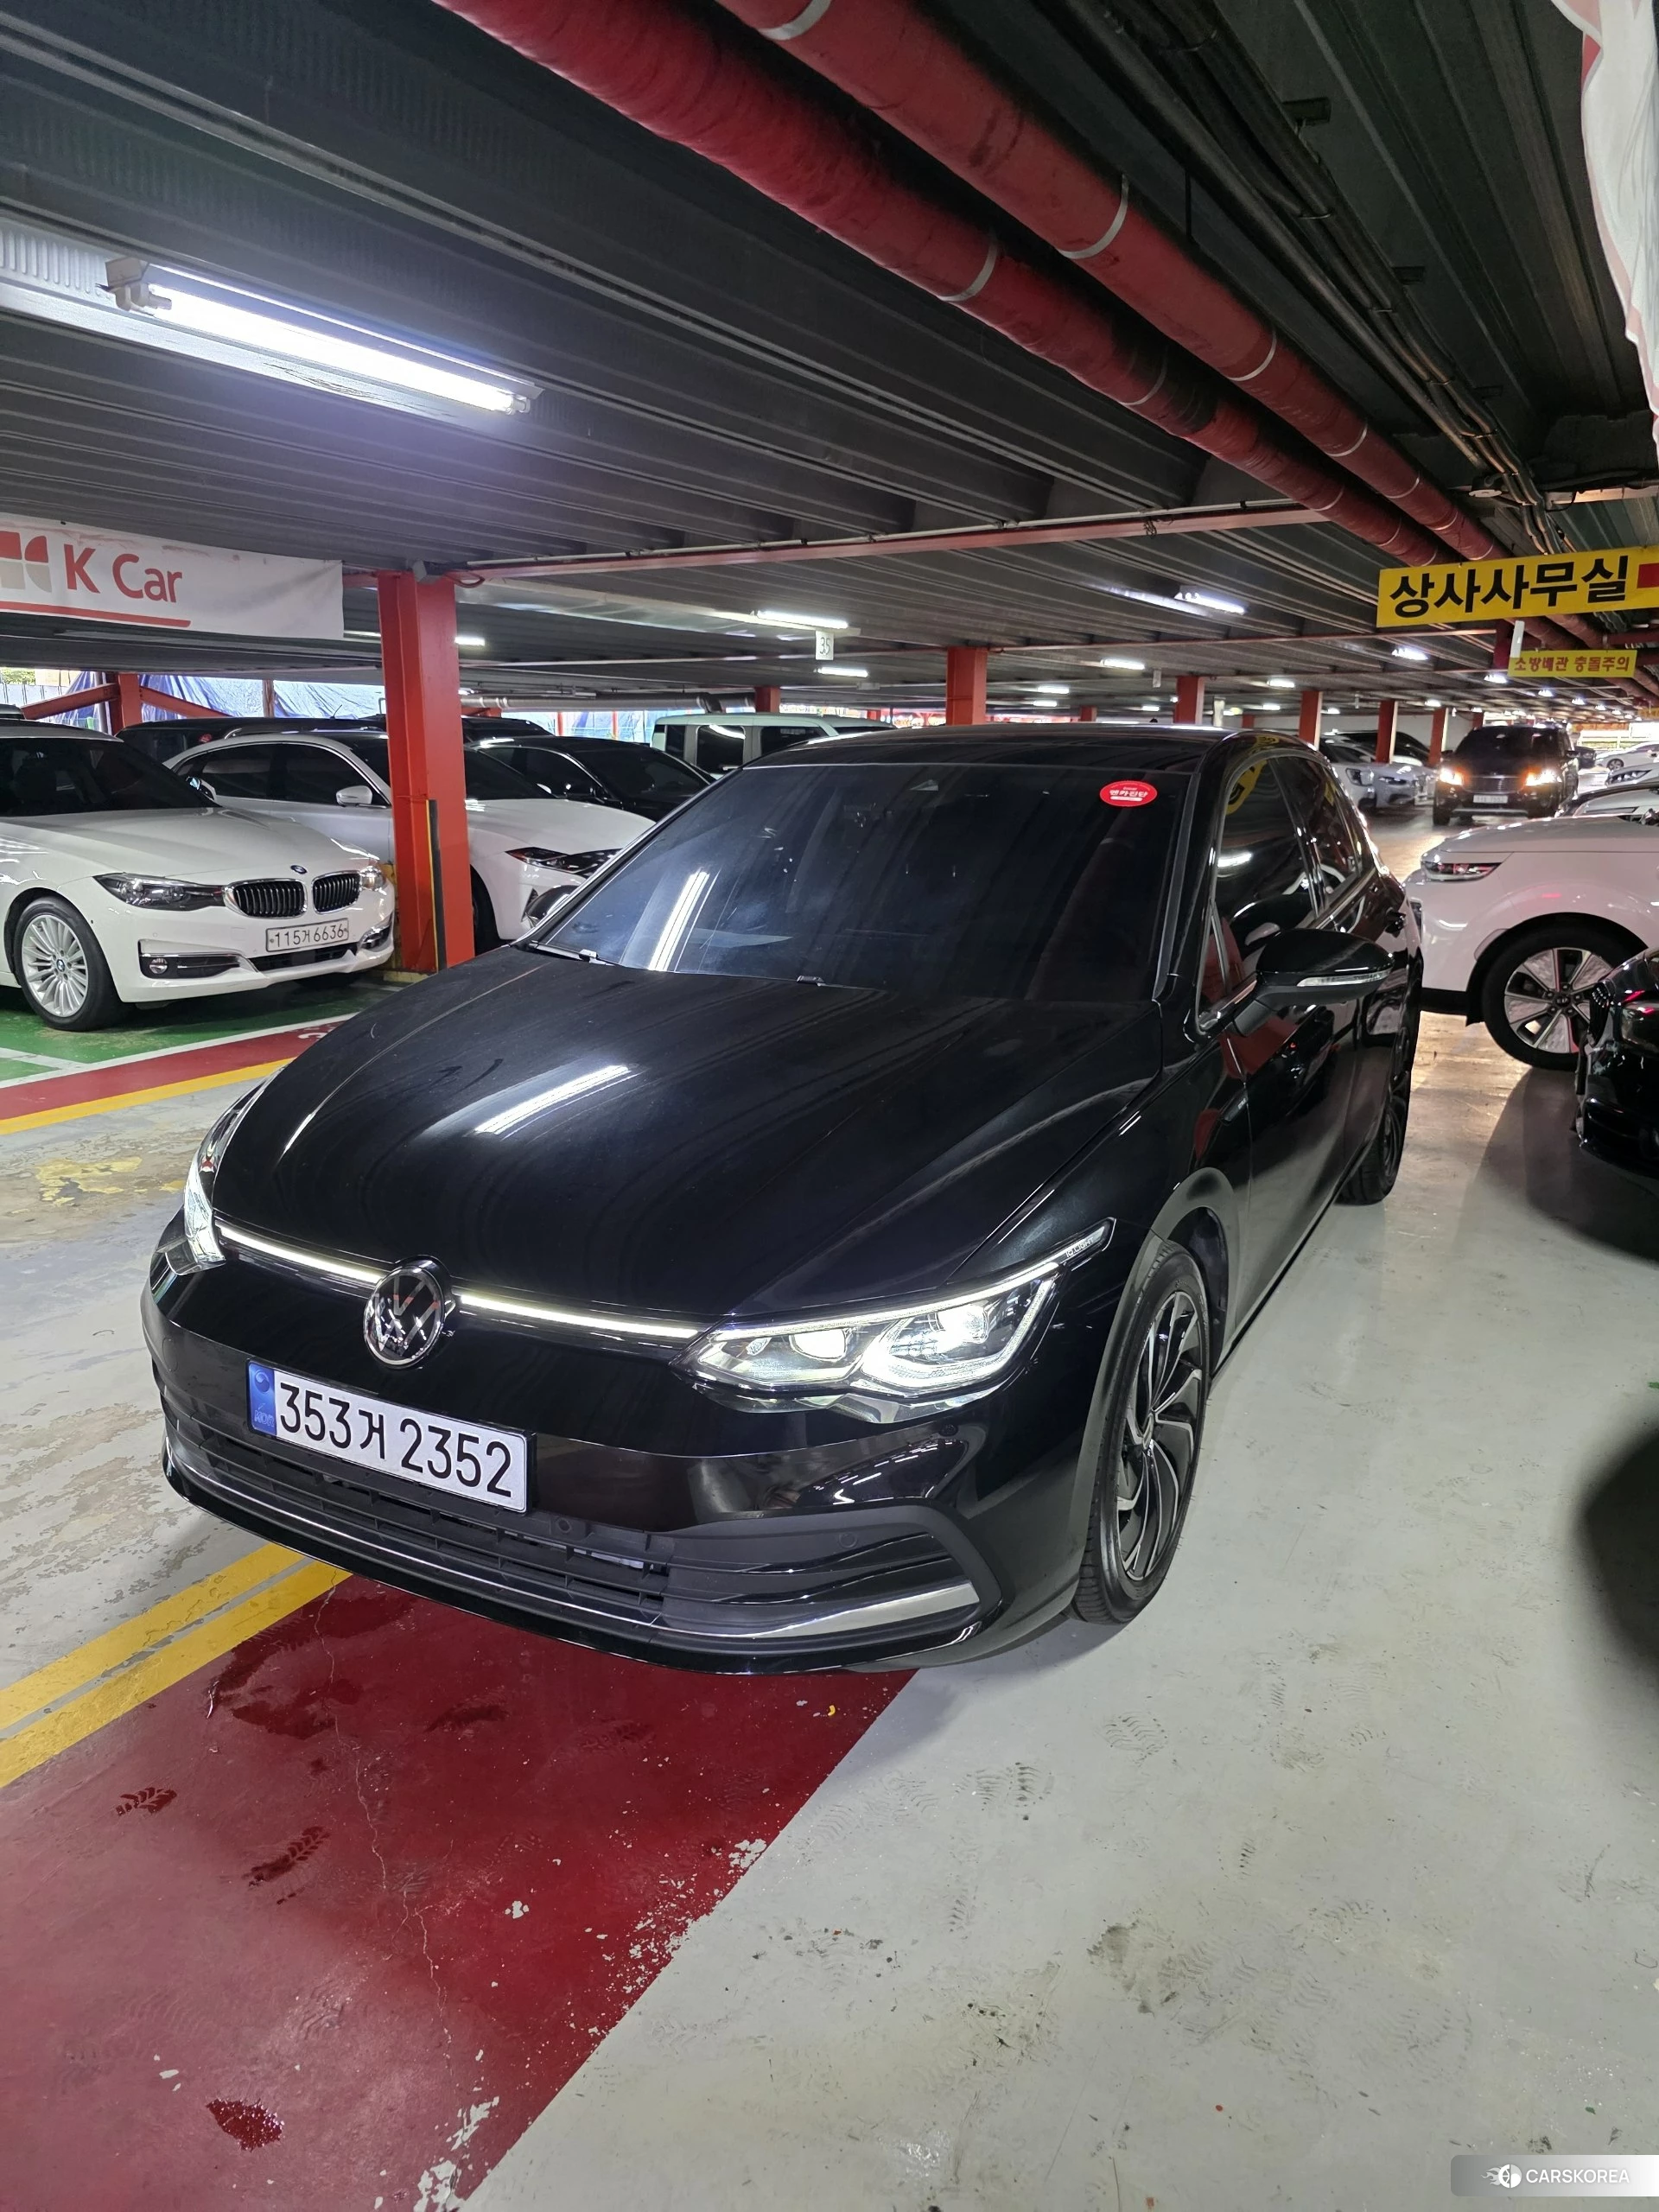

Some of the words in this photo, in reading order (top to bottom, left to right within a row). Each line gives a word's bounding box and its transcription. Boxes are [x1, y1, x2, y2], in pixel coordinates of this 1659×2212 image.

[63, 543, 101, 594] K
[111, 553, 183, 603] Car
[1389, 555, 1629, 619] 상사사무실
[819, 636, 831, 656] 35
[1514, 656, 1569, 672] 소방배관
[1574, 656, 1630, 673] 충돌주의
[275, 929, 310, 948] 115거
[313, 923, 344, 943] 6636
[254, 1409, 275, 1427] KOR
[279, 1382, 385, 1460] 353거
[399, 1418, 512, 1498] 2352
